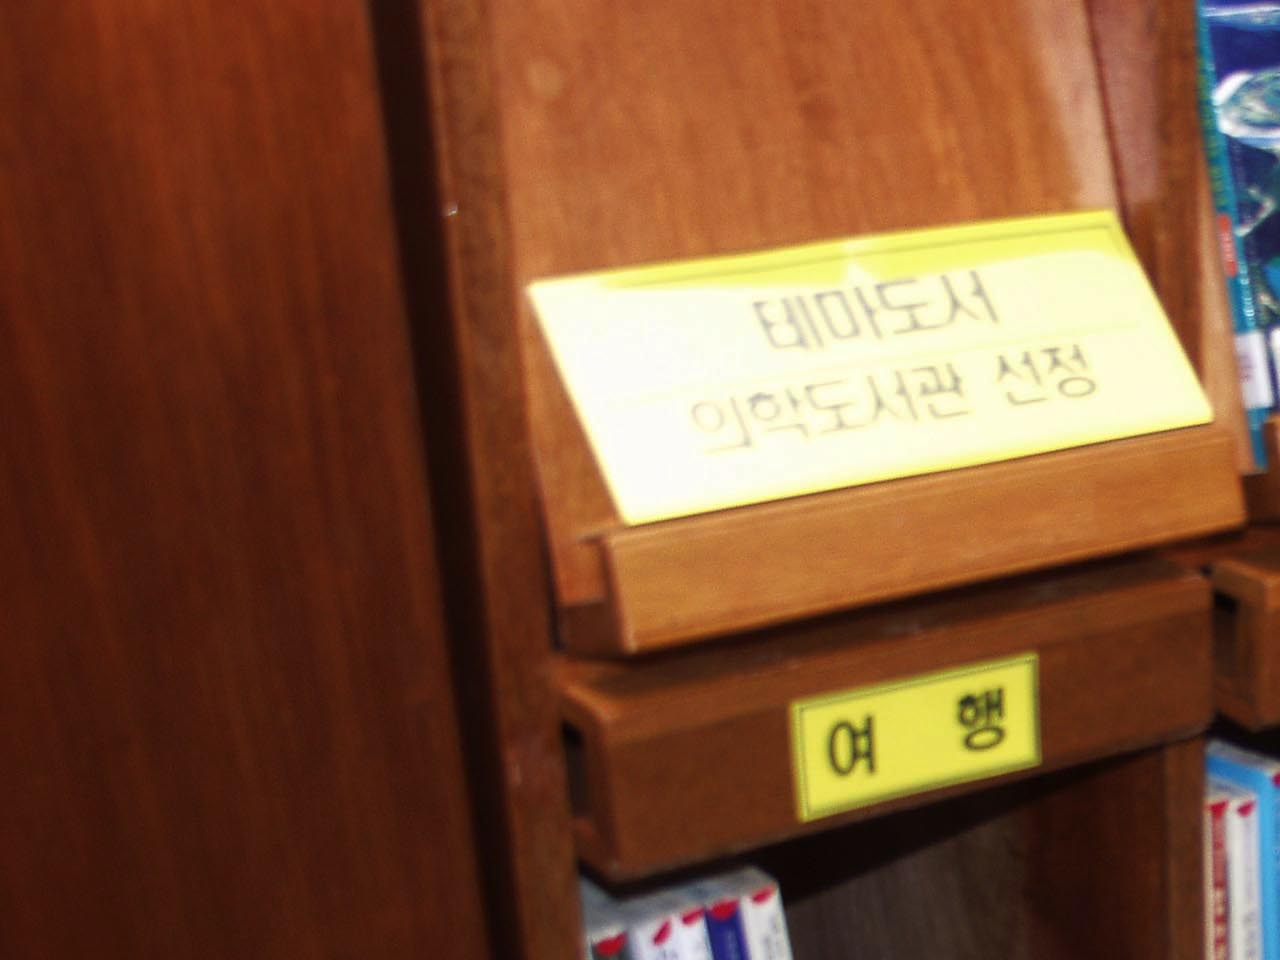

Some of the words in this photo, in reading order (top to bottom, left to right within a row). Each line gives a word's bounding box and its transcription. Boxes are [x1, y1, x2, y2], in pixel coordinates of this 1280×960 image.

[752, 268, 999, 352] 테마도서
[688, 362, 972, 456] 의학도서관
[996, 342, 1098, 407] 선정
